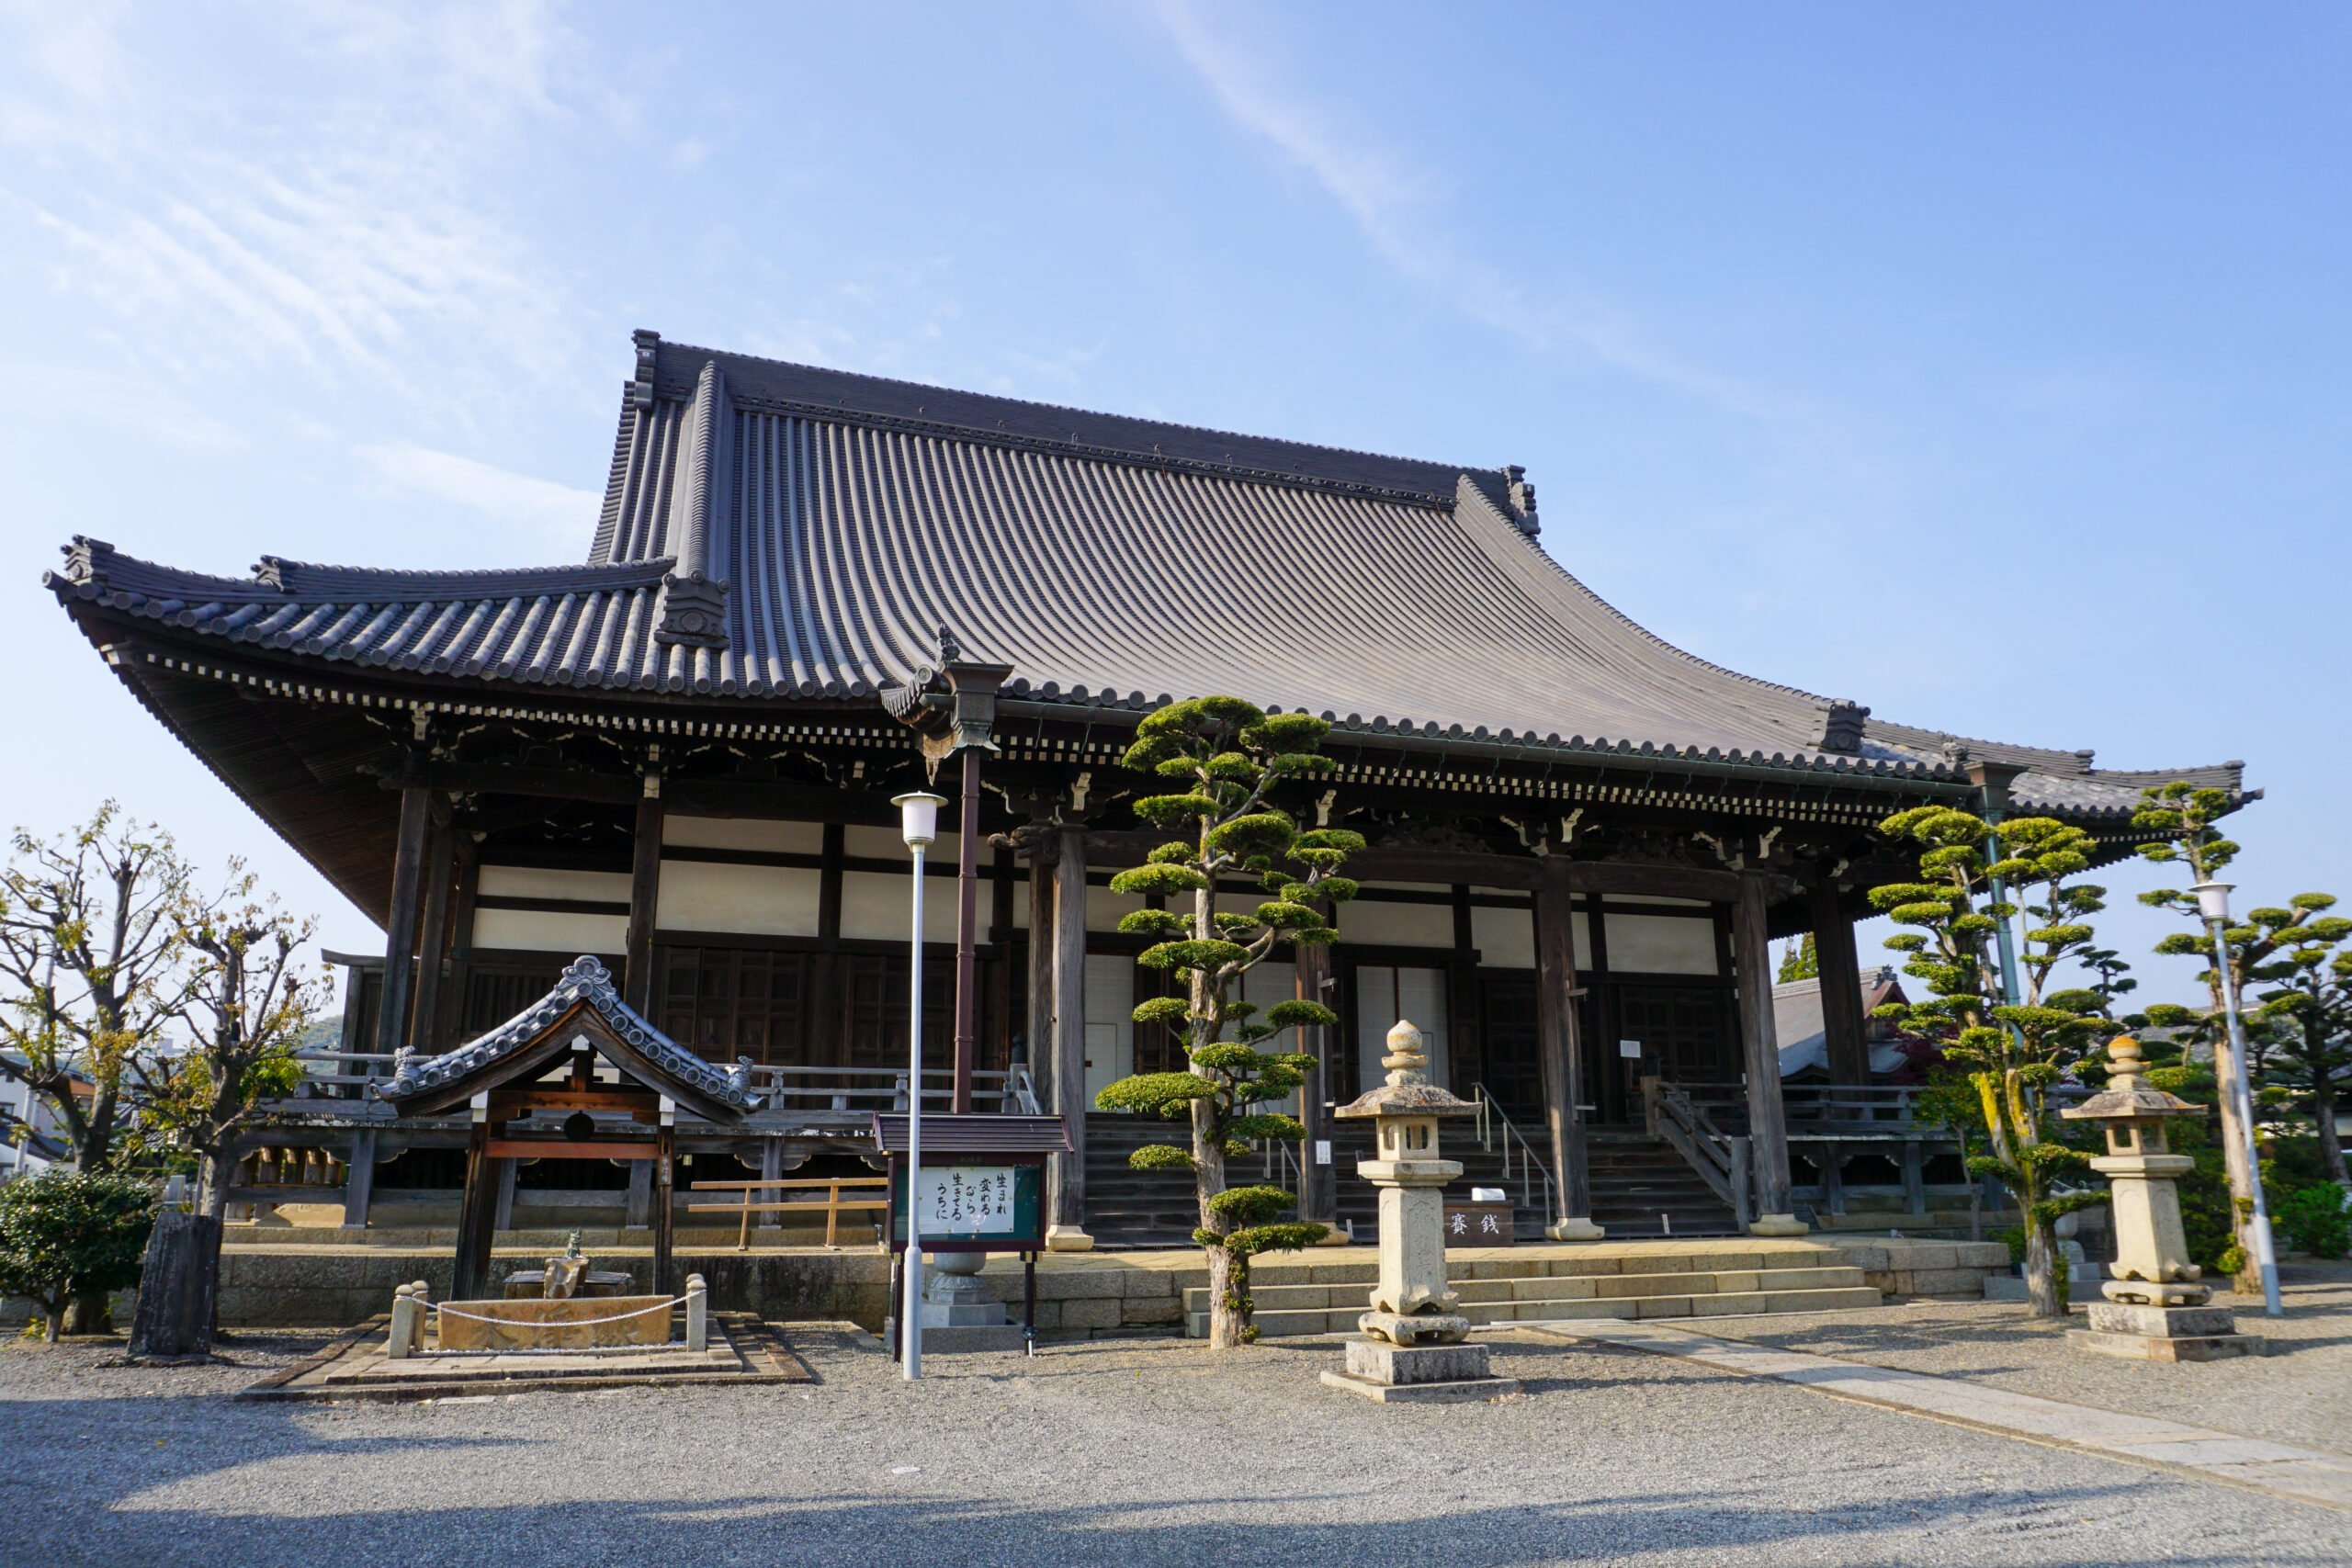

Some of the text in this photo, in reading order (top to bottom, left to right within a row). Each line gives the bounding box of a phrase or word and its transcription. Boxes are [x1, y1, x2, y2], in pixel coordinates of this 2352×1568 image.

[936, 1182, 948, 1220] うちに
[951, 1172, 964, 1221] 生きてる
[966, 1185, 976, 1213] なら
[979, 1178, 991, 1215] 変わる
[996, 1172, 1007, 1214] 生まれ
